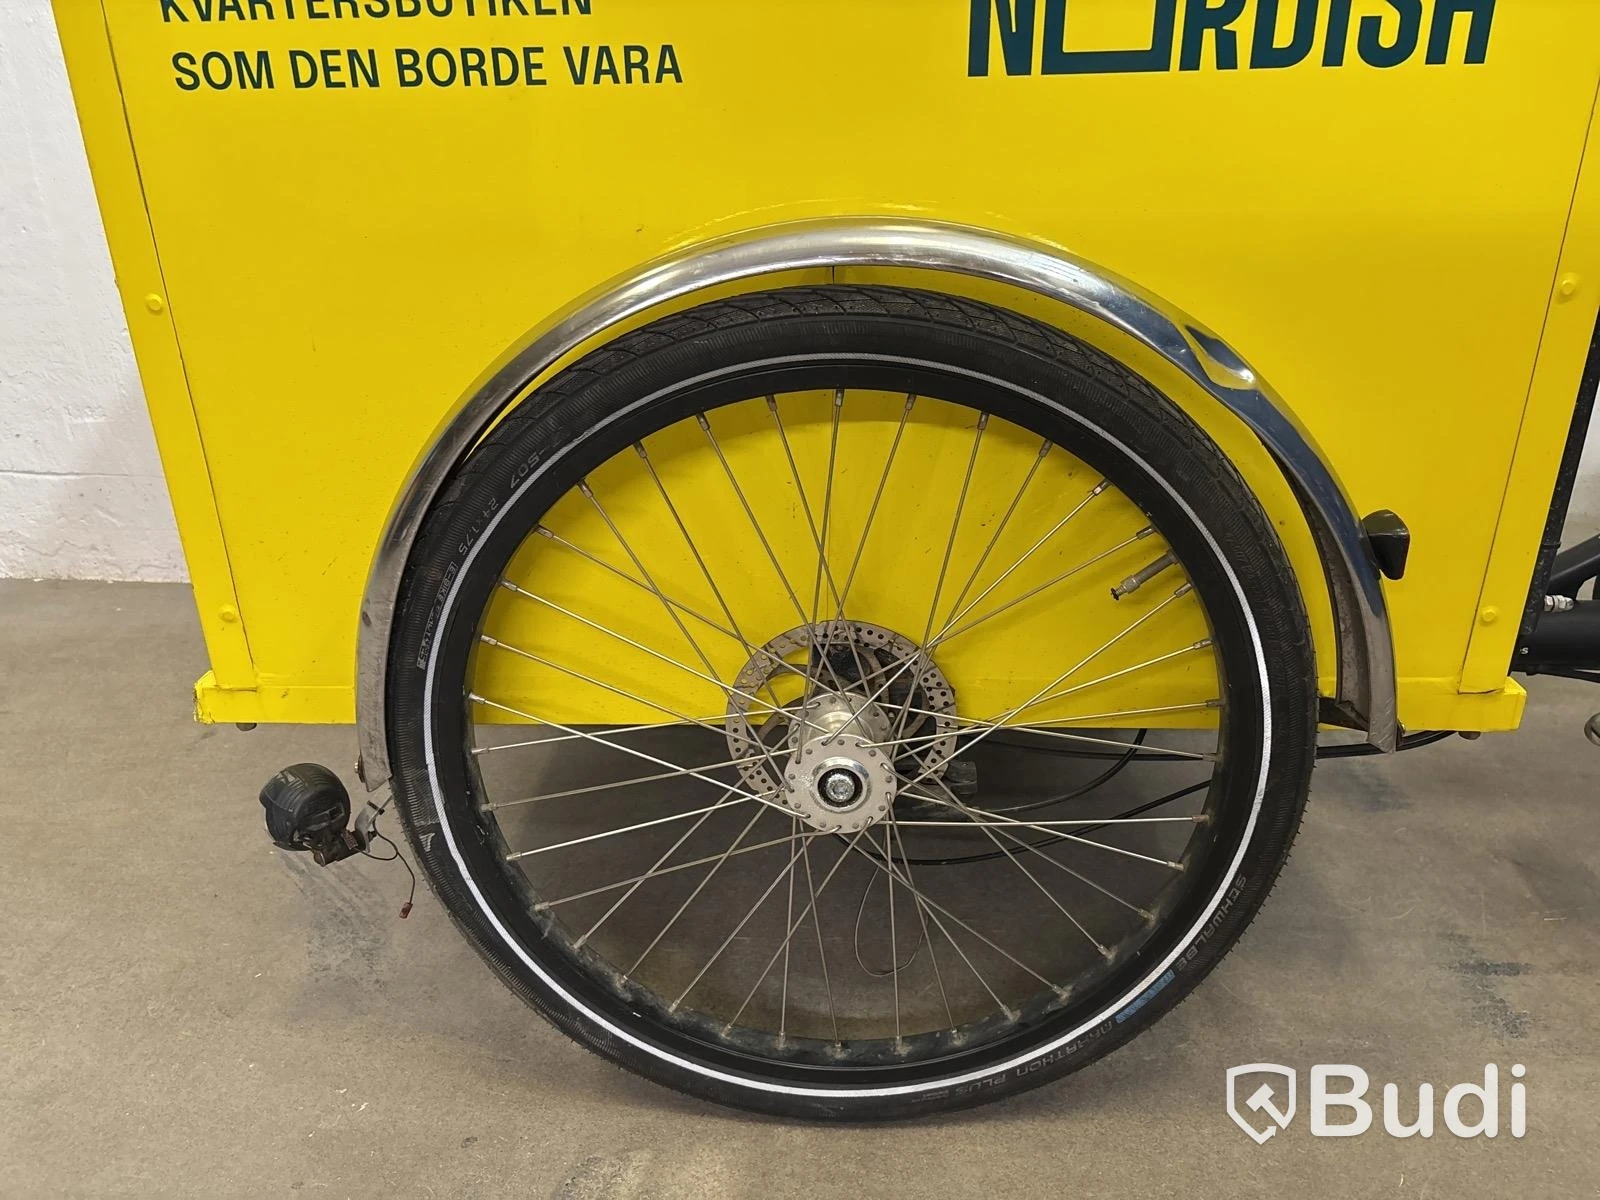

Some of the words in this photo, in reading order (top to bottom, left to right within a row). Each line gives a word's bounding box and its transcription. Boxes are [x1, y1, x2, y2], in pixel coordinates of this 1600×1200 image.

[172, 51, 275, 91] SOM
[289, 49, 380, 89] DEN
[394, 46, 547, 88] BORDE
[563, 44, 683, 85] VARA
[1177, 873, 1247, 971] SCHWALBE
